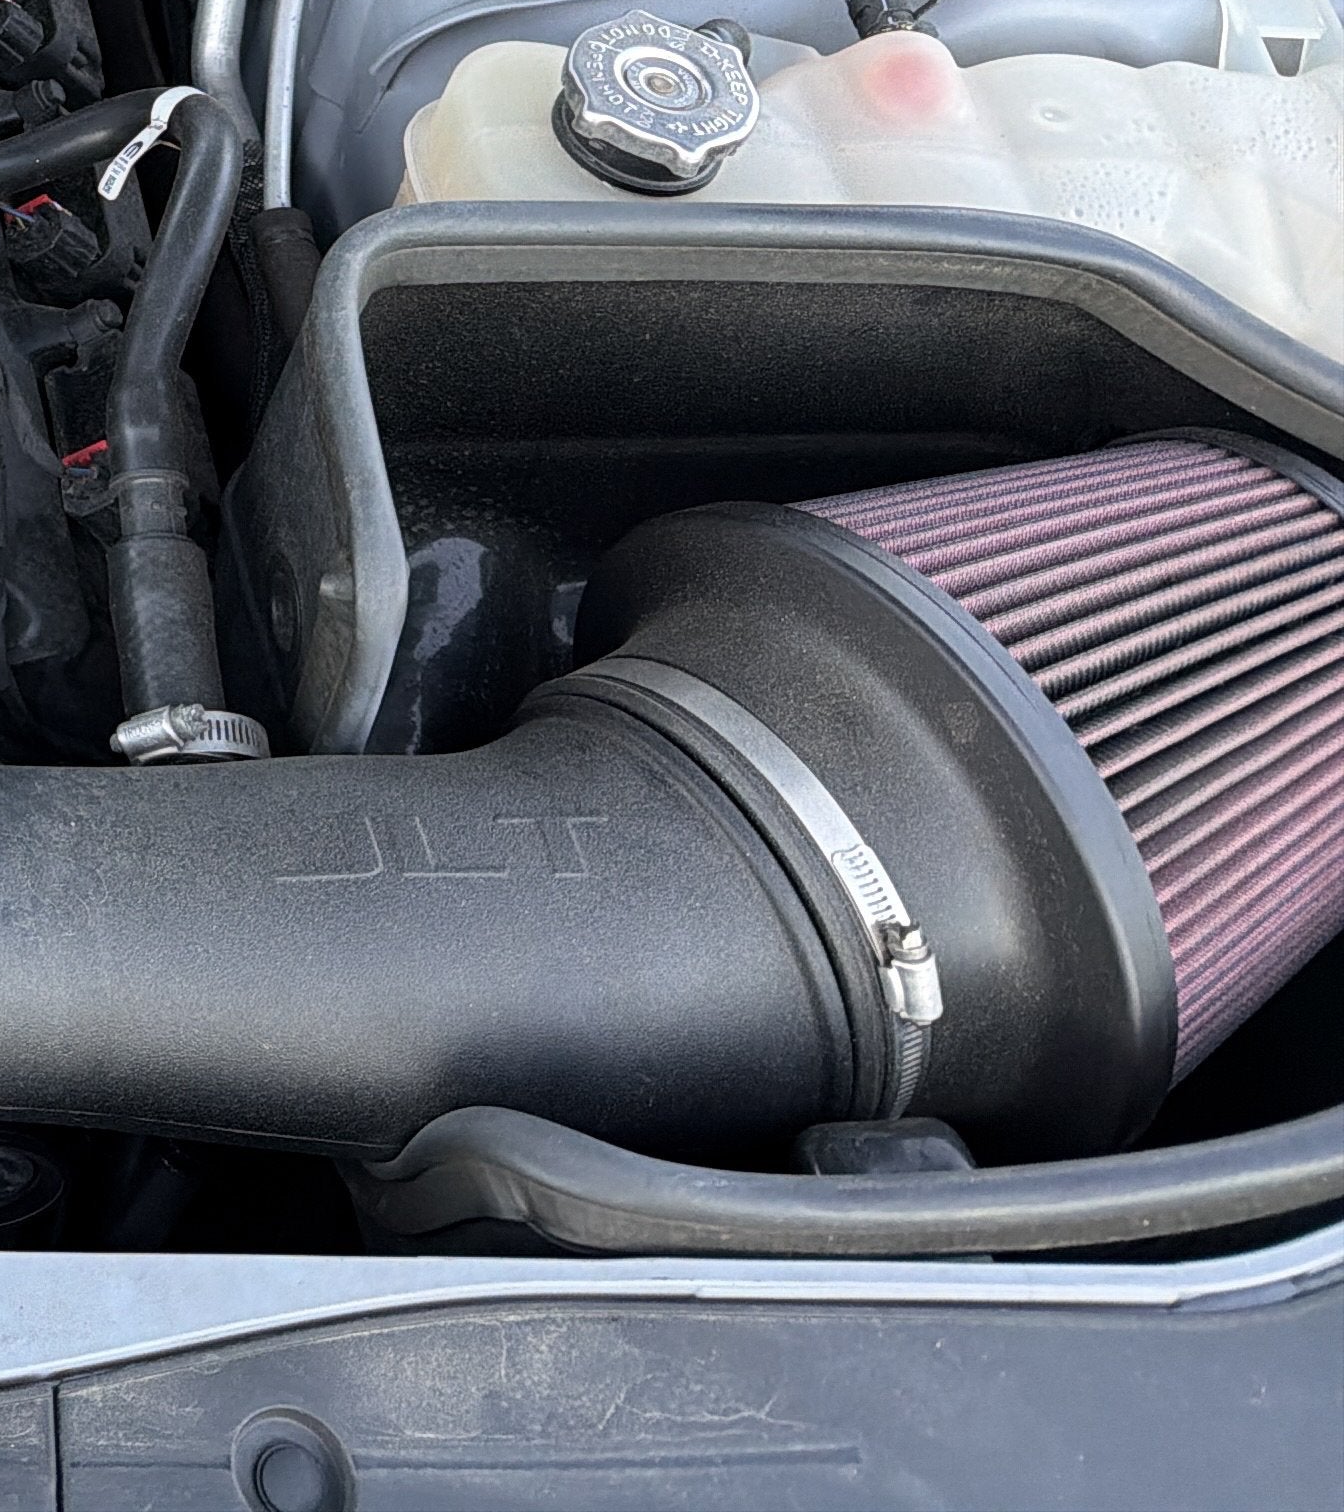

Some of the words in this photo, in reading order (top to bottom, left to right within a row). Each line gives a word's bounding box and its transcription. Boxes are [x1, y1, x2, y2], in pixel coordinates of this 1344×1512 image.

[719, 57, 747, 106] KEEP
[694, 109, 743, 136] TIGHT
[274, 815, 609, 882] JLT
